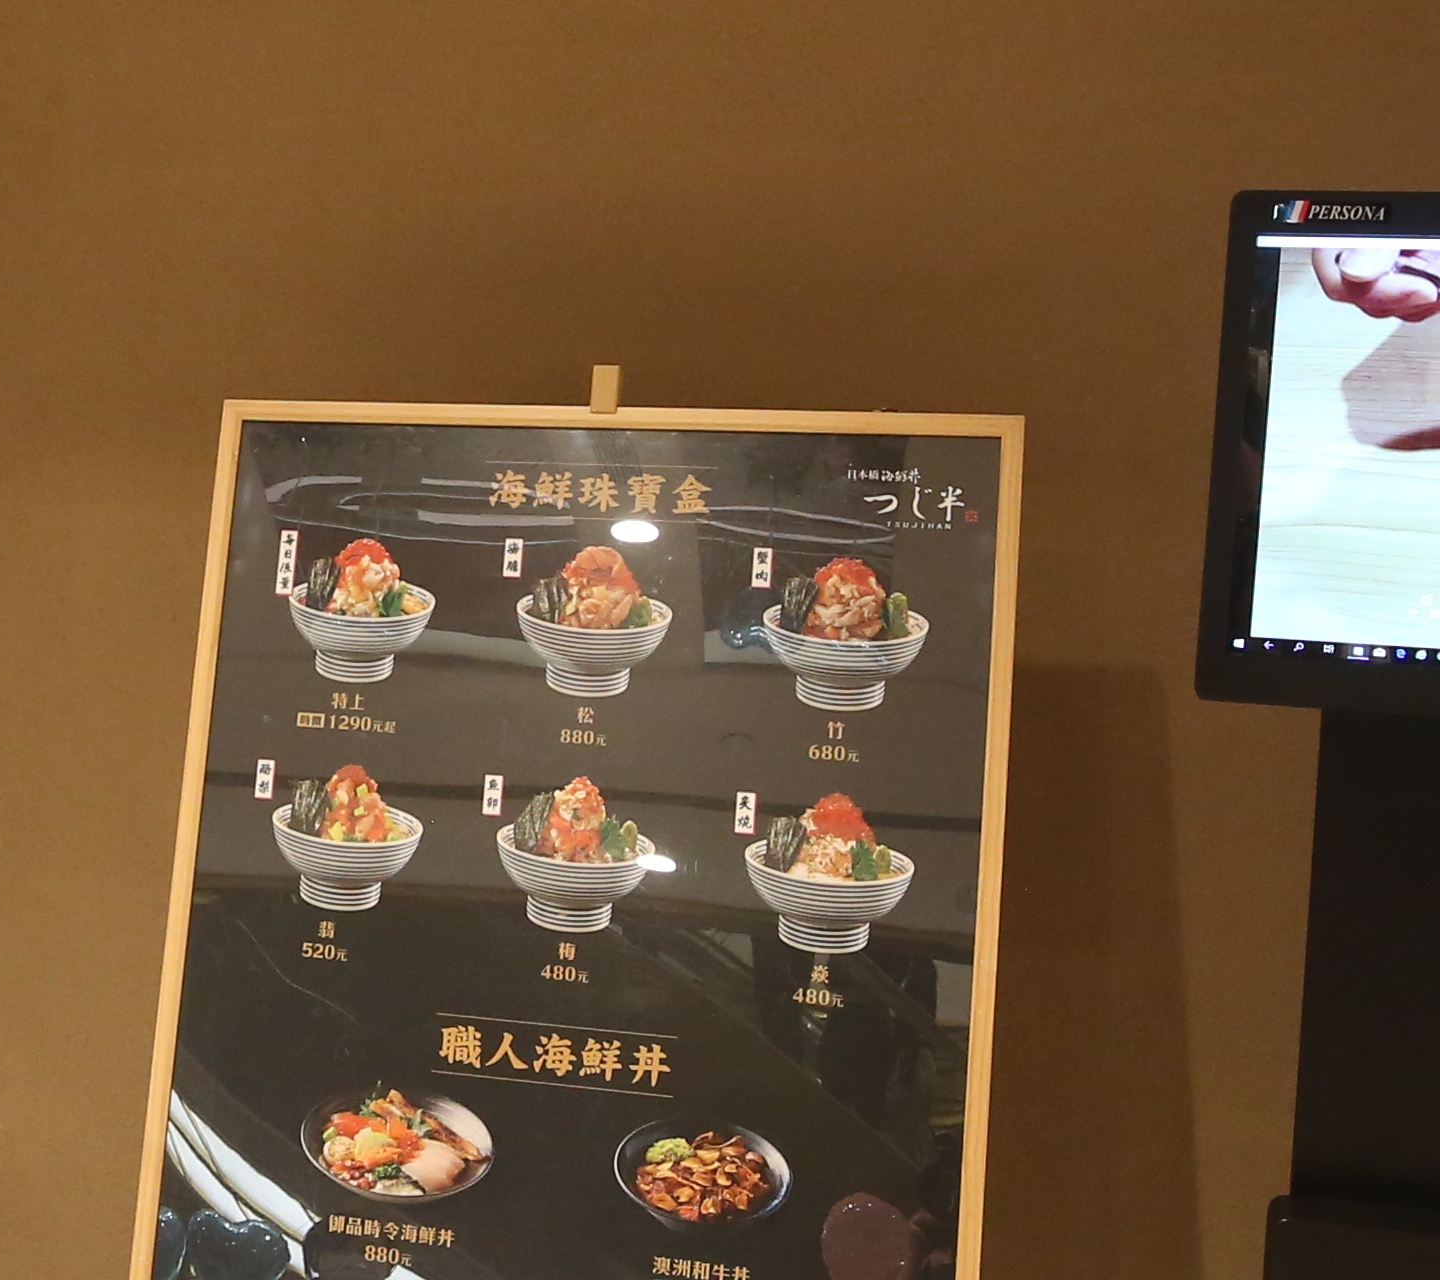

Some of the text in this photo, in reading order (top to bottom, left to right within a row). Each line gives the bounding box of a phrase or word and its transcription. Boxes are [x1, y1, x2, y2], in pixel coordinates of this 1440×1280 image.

[1307, 204, 1386, 221] PERSONA
[489, 469, 713, 514] 海鮮珠寶盒
[863, 485, 966, 522] つじ半
[886, 520, 953, 531] TSUJIHAN
[331, 691, 365, 711] 特上
[576, 706, 595, 724] 松
[559, 728, 607, 747] 880元
[826, 720, 846, 740] 竹
[808, 744, 860, 764] 680元
[301, 942, 349, 963] 520元
[557, 941, 577, 961] 梅
[540, 964, 590, 984] 480元
[792, 987, 845, 1009] 480元
[438, 1024, 672, 1088] 職人海鮮丼
[328, 1214, 456, 1249] 御品時令海鮮丼
[364, 1244, 413, 1267] 880元
